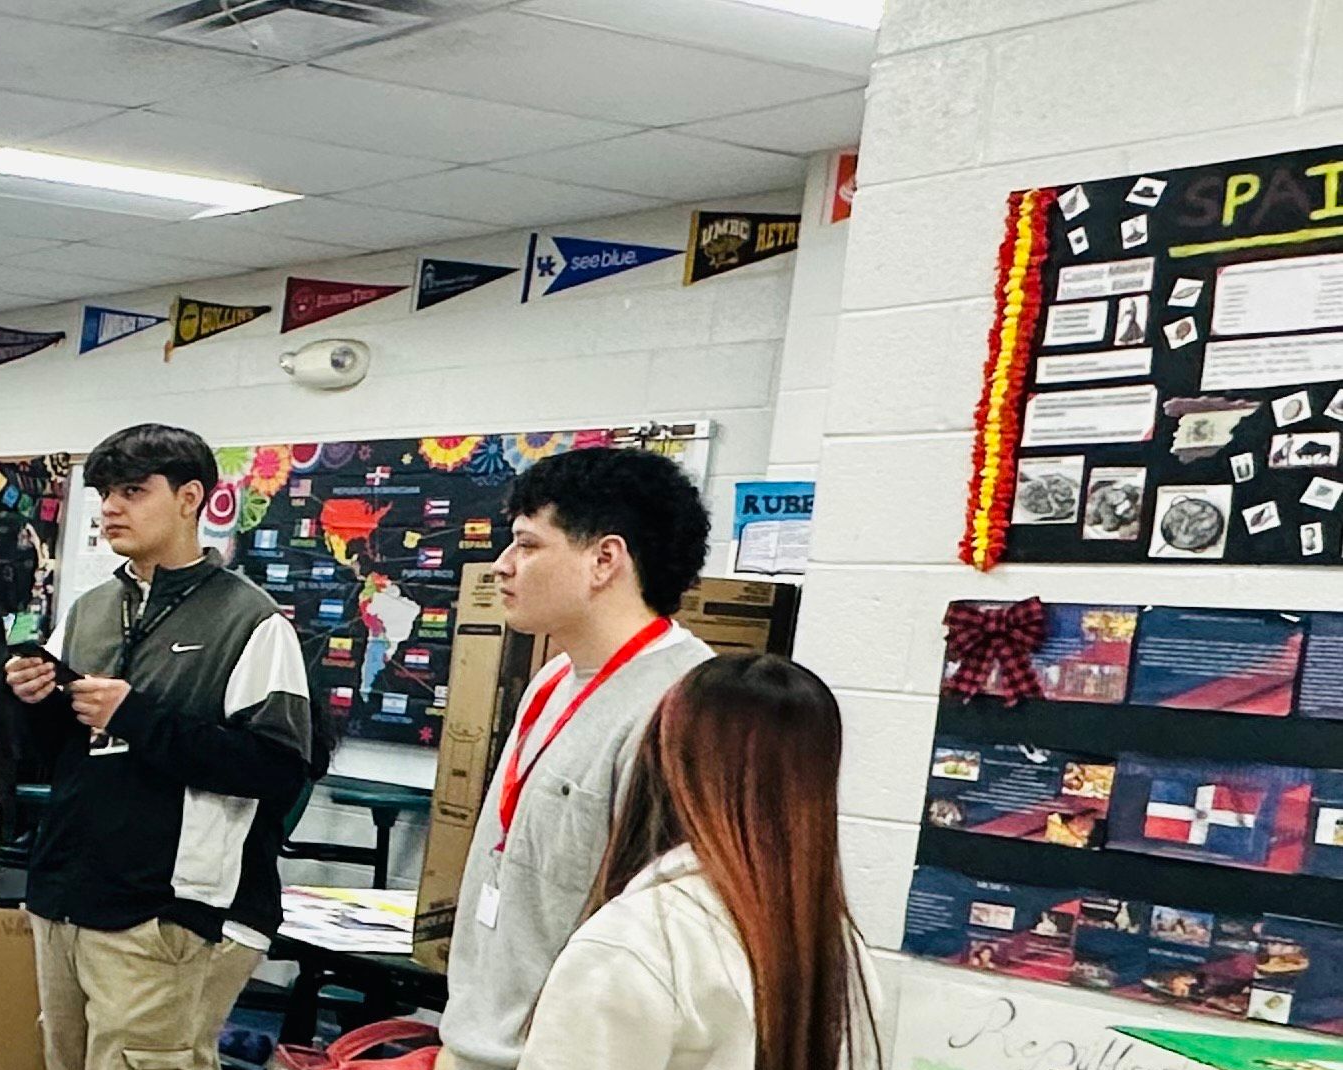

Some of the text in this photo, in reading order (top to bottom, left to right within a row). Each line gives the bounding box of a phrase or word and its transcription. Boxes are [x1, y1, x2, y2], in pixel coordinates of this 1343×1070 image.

[701, 219, 751, 245] UMBC
[756, 222, 801, 251] RETR
[570, 255, 600, 270] see
